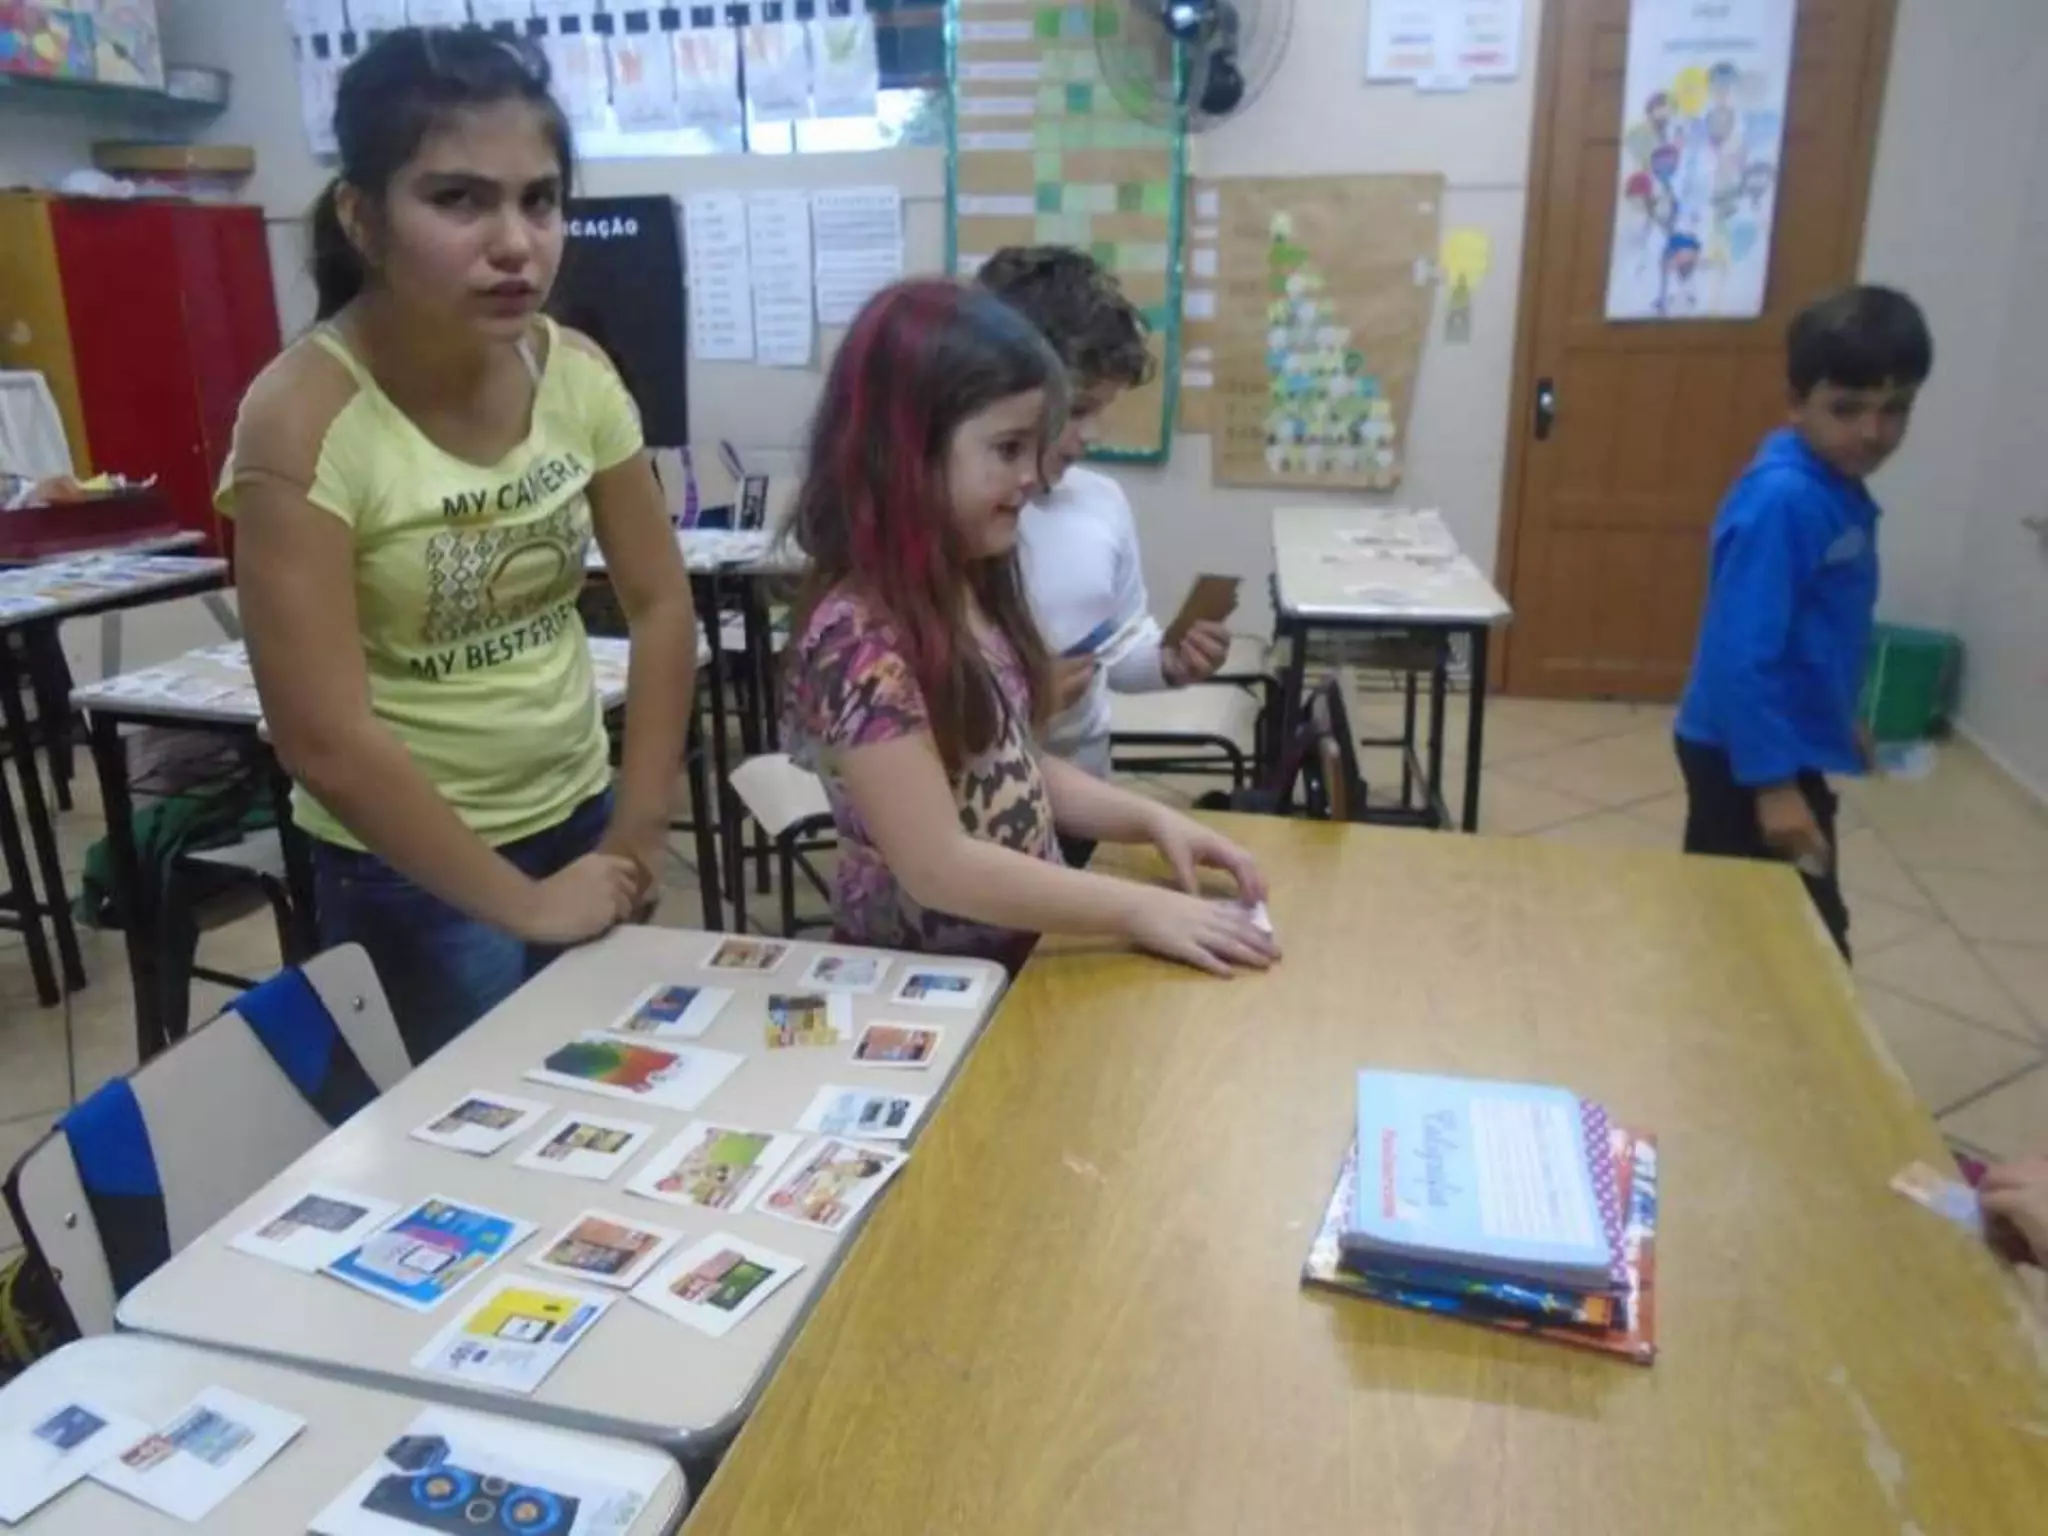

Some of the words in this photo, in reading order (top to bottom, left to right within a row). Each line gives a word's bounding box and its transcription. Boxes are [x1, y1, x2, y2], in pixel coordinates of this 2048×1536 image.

[442, 489, 487, 517] MY
[409, 649, 455, 681] MY
[464, 627, 526, 671] BEST
